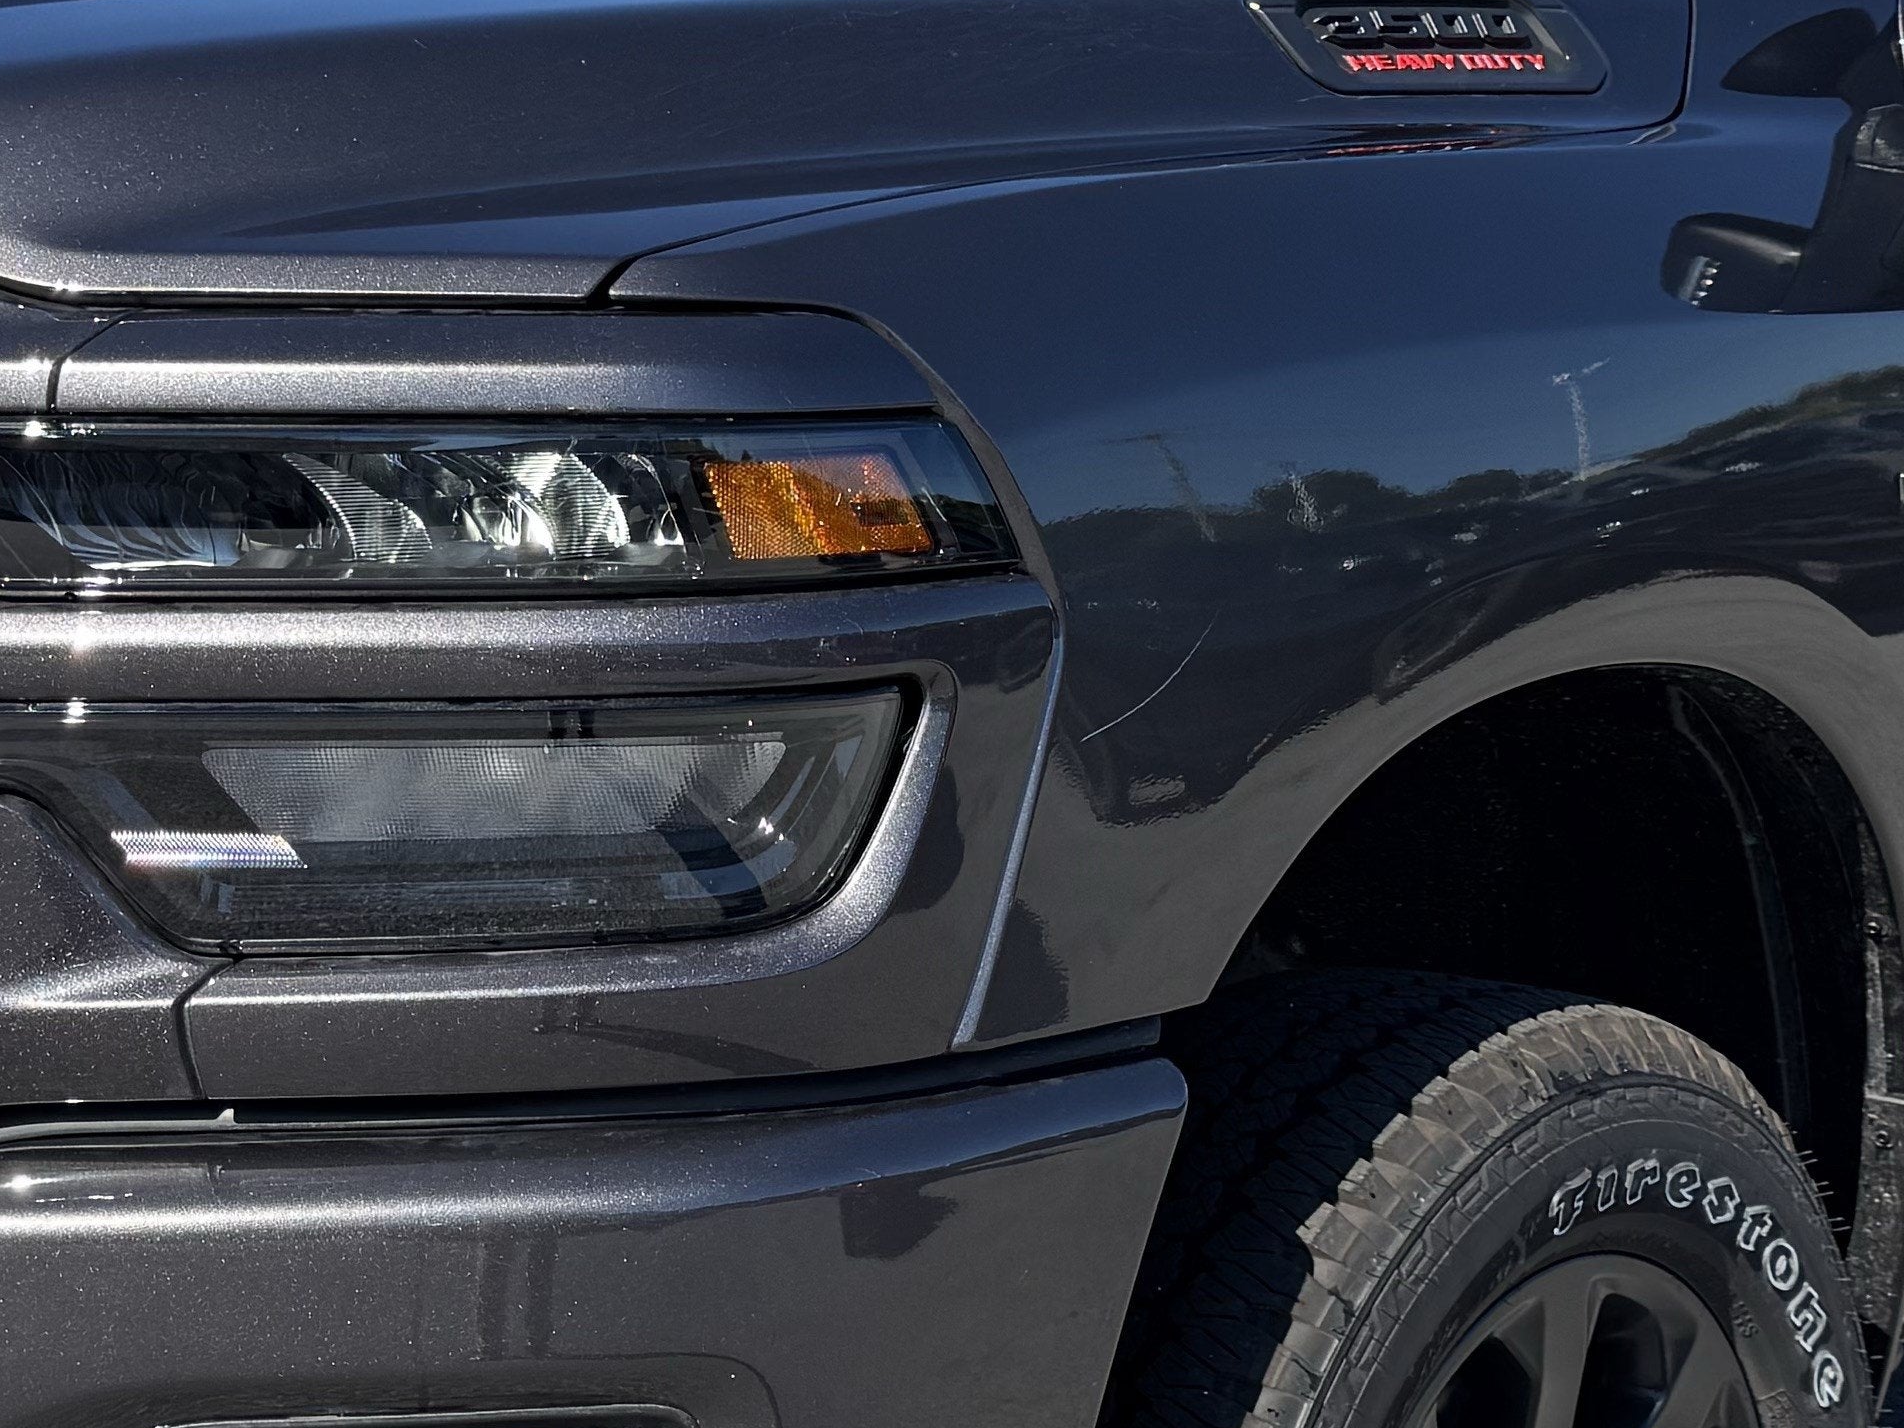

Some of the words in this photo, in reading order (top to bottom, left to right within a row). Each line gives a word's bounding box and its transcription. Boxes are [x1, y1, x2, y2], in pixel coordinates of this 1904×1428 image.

[1343, 54, 1454, 71] HEAVY
[1459, 54, 1544, 71] DUTY
[1548, 1157, 1845, 1408] Firestone
